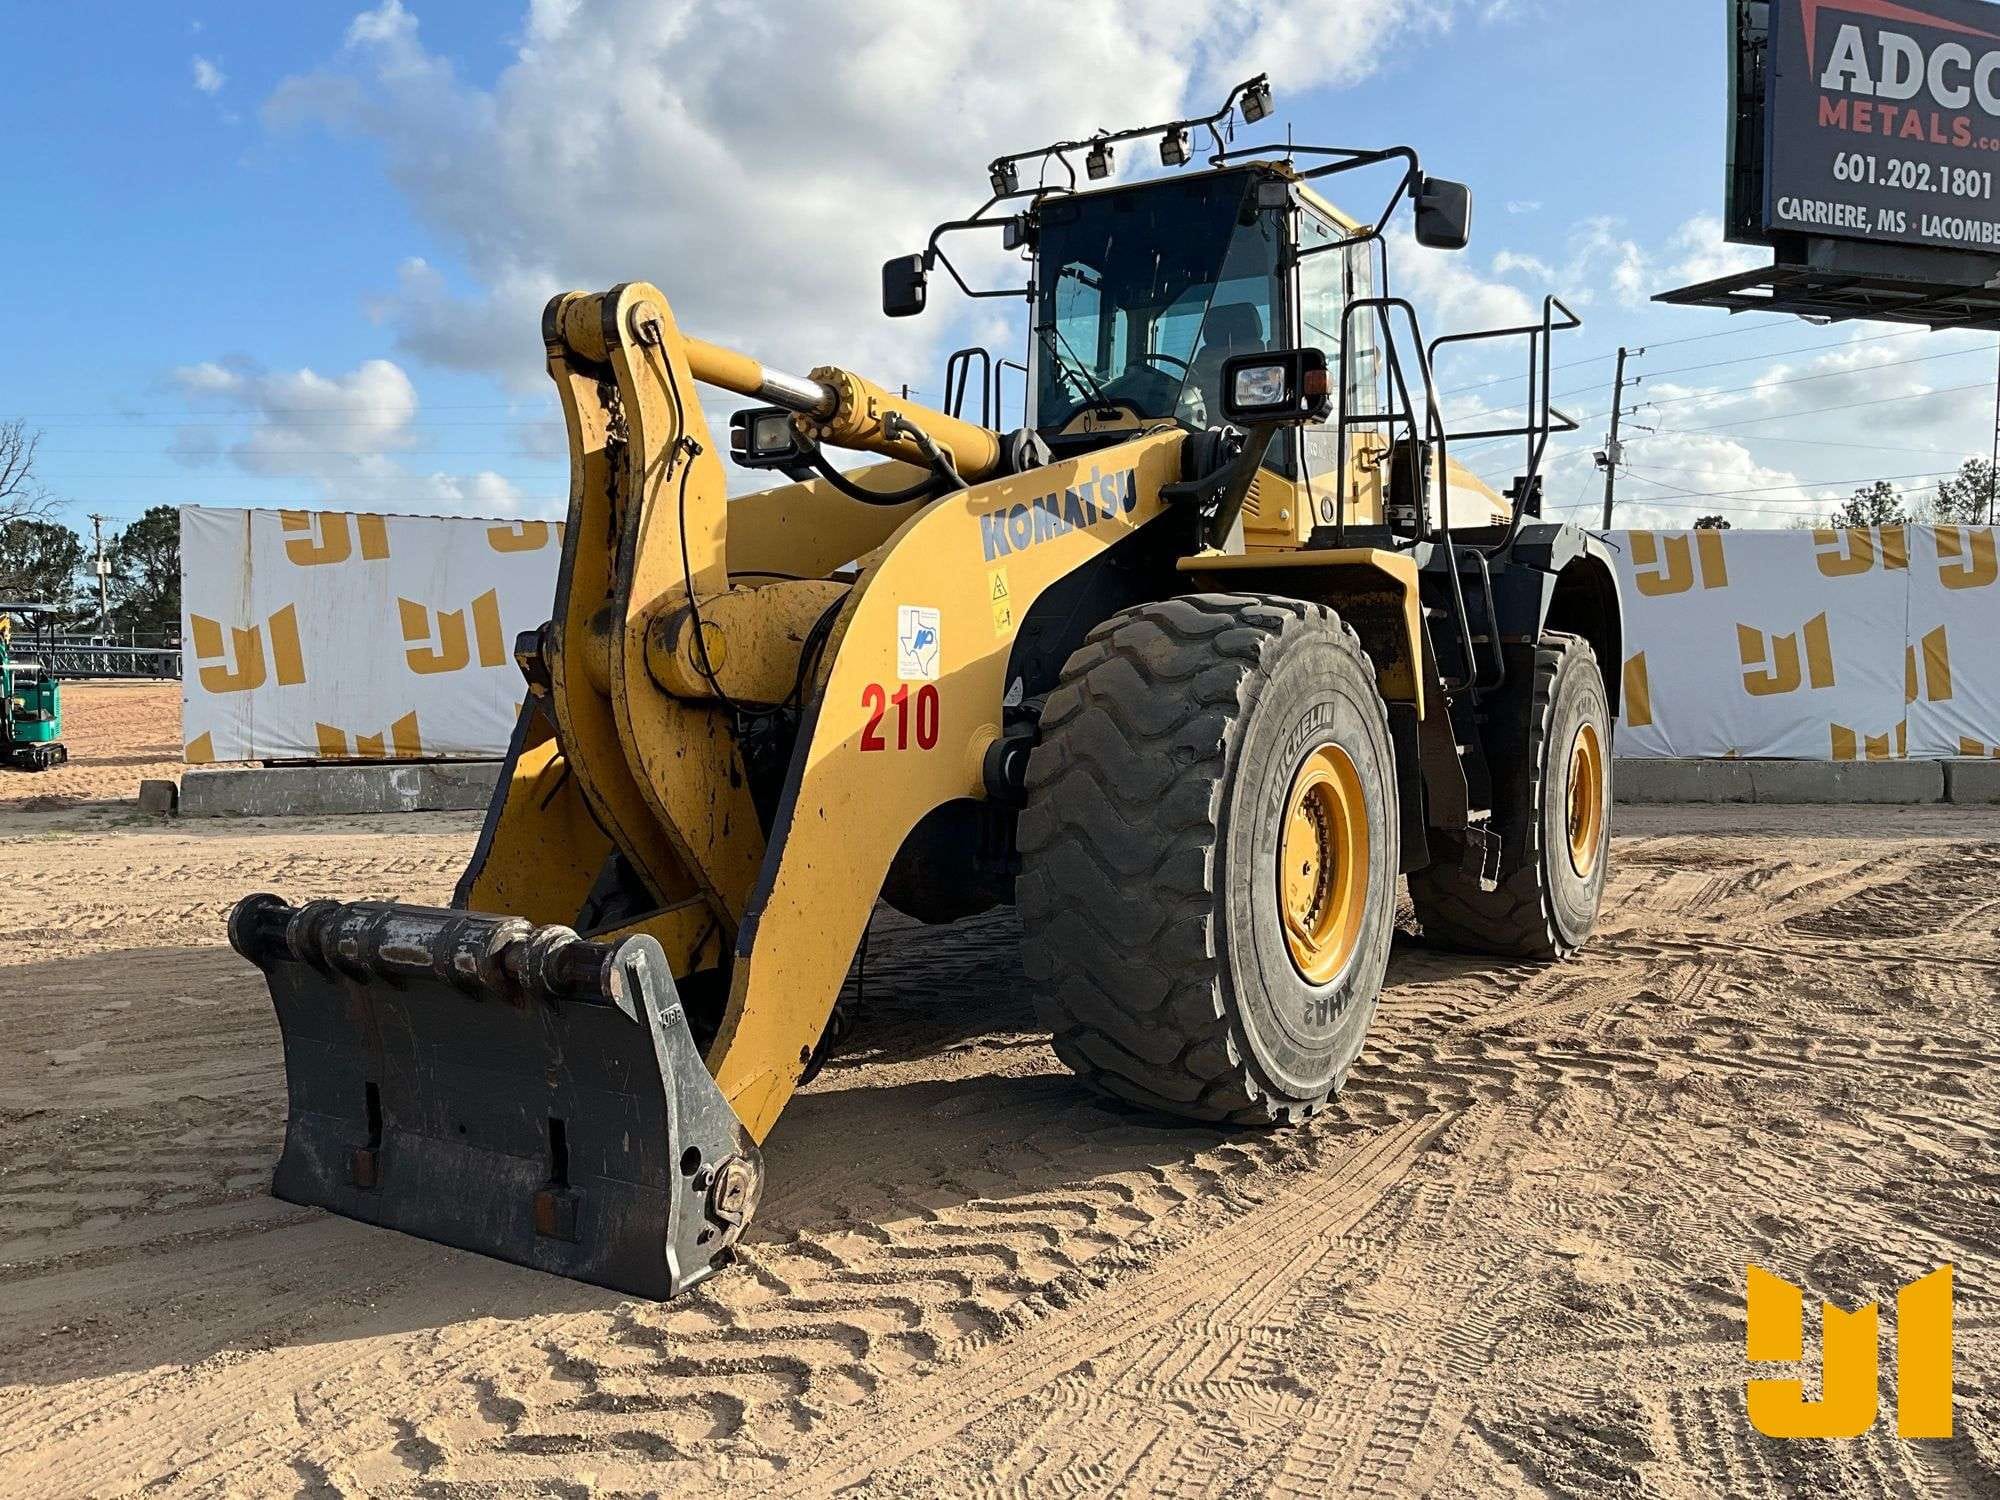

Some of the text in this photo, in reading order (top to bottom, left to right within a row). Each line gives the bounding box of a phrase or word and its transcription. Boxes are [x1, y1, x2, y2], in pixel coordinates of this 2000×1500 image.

[1833, 152, 1991, 199] 601.202.1801
[1777, 197, 1872, 233] CARRIERE,
[1877, 209, 1906, 233] MS
[980, 465, 1137, 562] KOMATSU
[860, 683, 940, 752] 210
